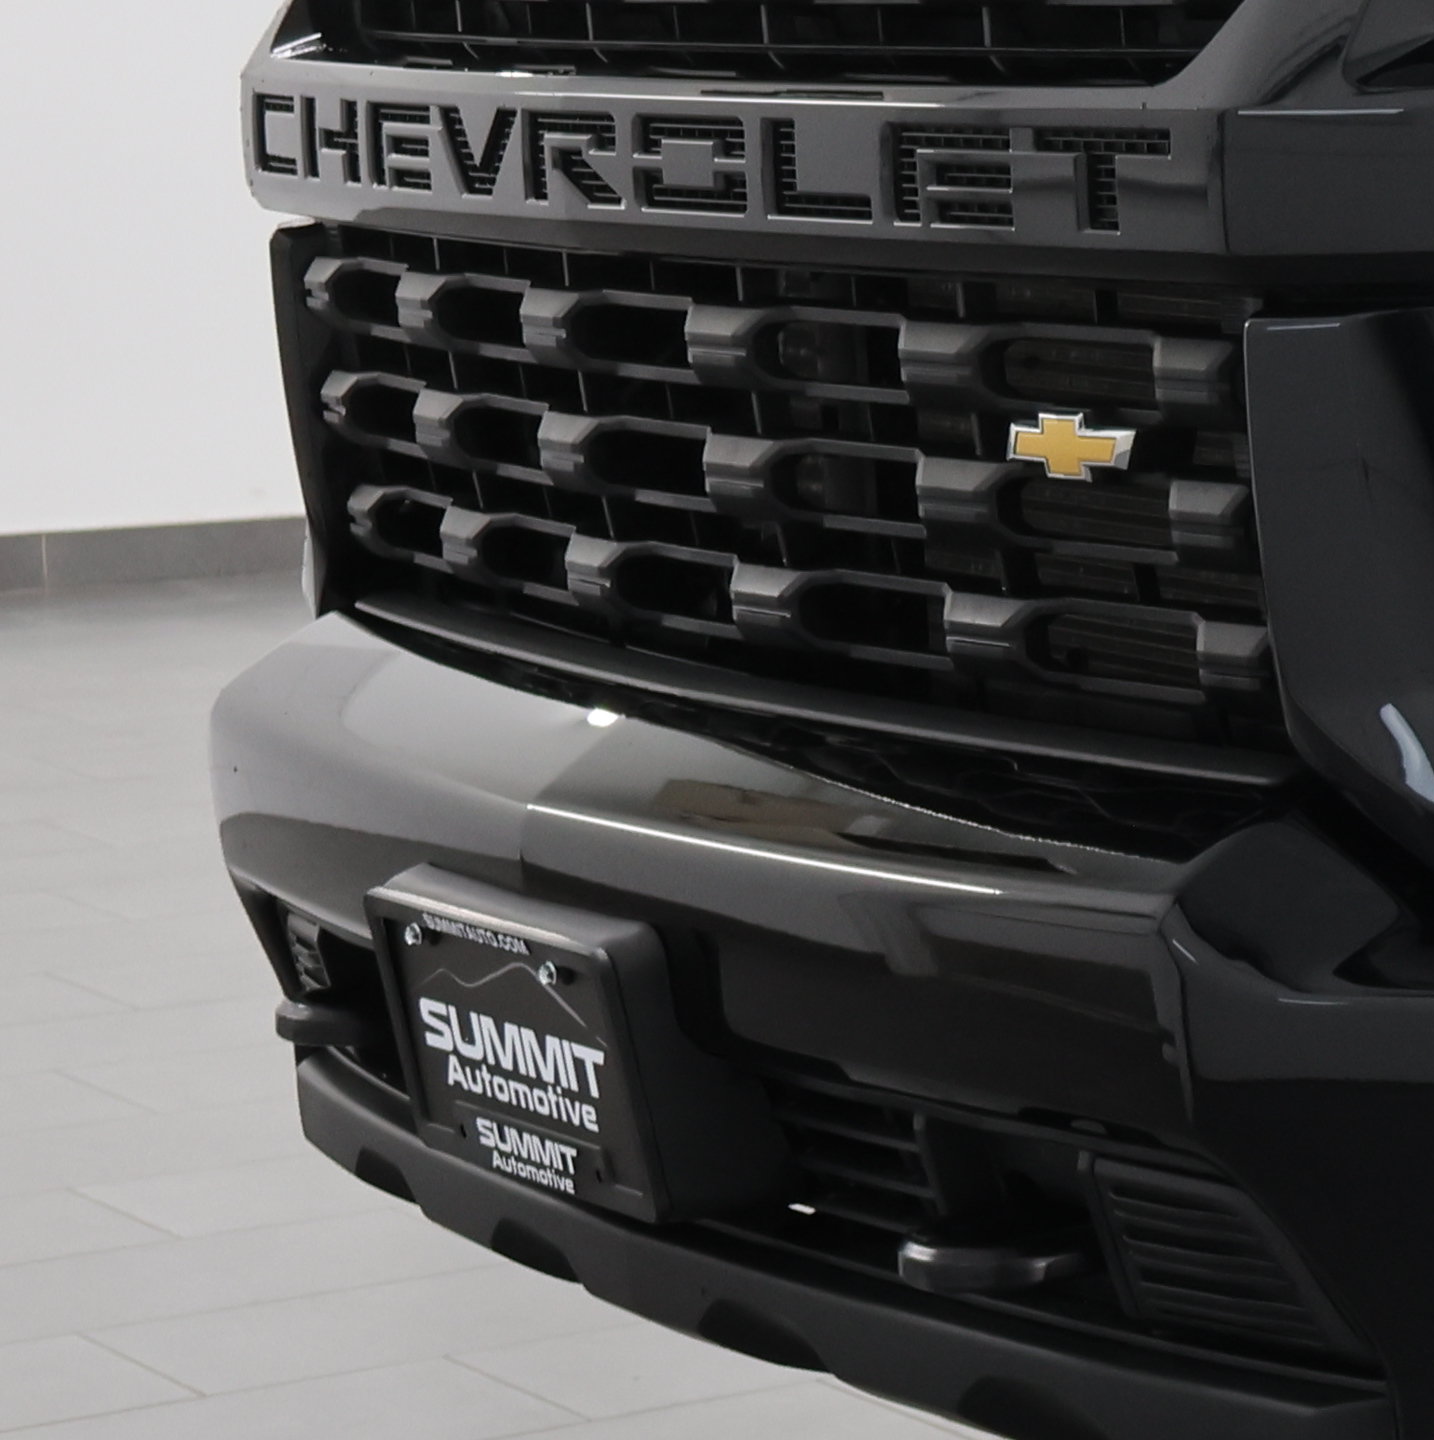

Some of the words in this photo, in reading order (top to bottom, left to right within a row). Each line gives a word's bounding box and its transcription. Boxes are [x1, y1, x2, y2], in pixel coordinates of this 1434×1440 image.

[252, 92, 1173, 235] CHEVROLET
[419, 997, 604, 1099] SUMMIT
[447, 1056, 600, 1133] Automotive
[476, 1116, 577, 1175] SUMMIT
[492, 1151, 576, 1196] Automotive
